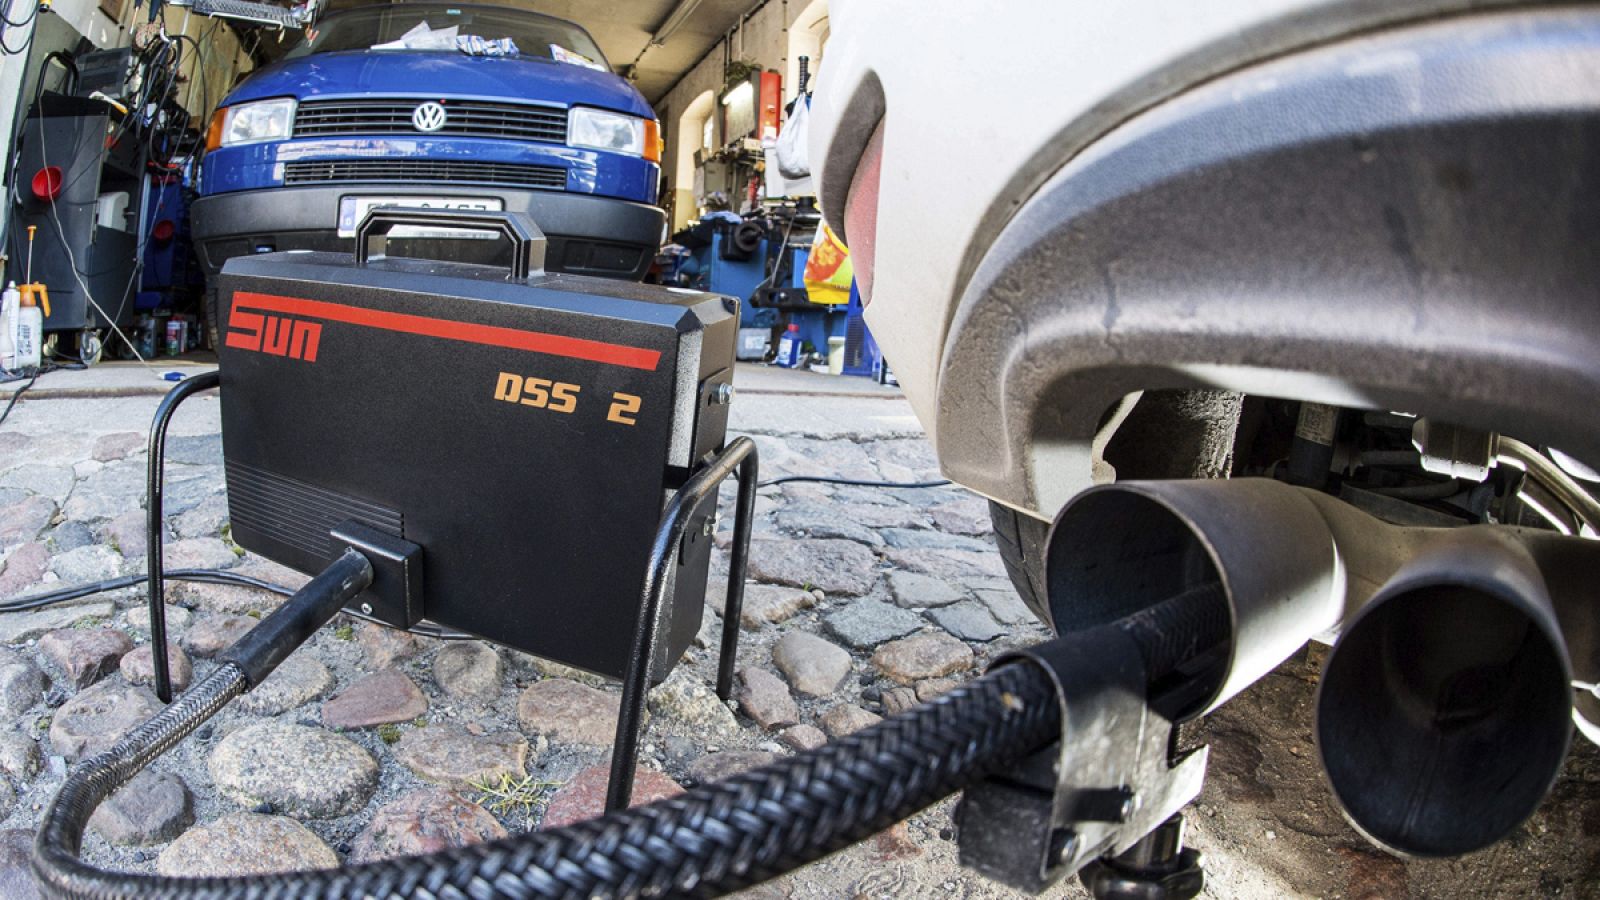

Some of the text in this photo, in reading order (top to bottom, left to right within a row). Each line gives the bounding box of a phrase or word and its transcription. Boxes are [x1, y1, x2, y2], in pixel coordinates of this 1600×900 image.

[412, 102, 446, 132] VW
[494, 371, 642, 426] DSS 2
